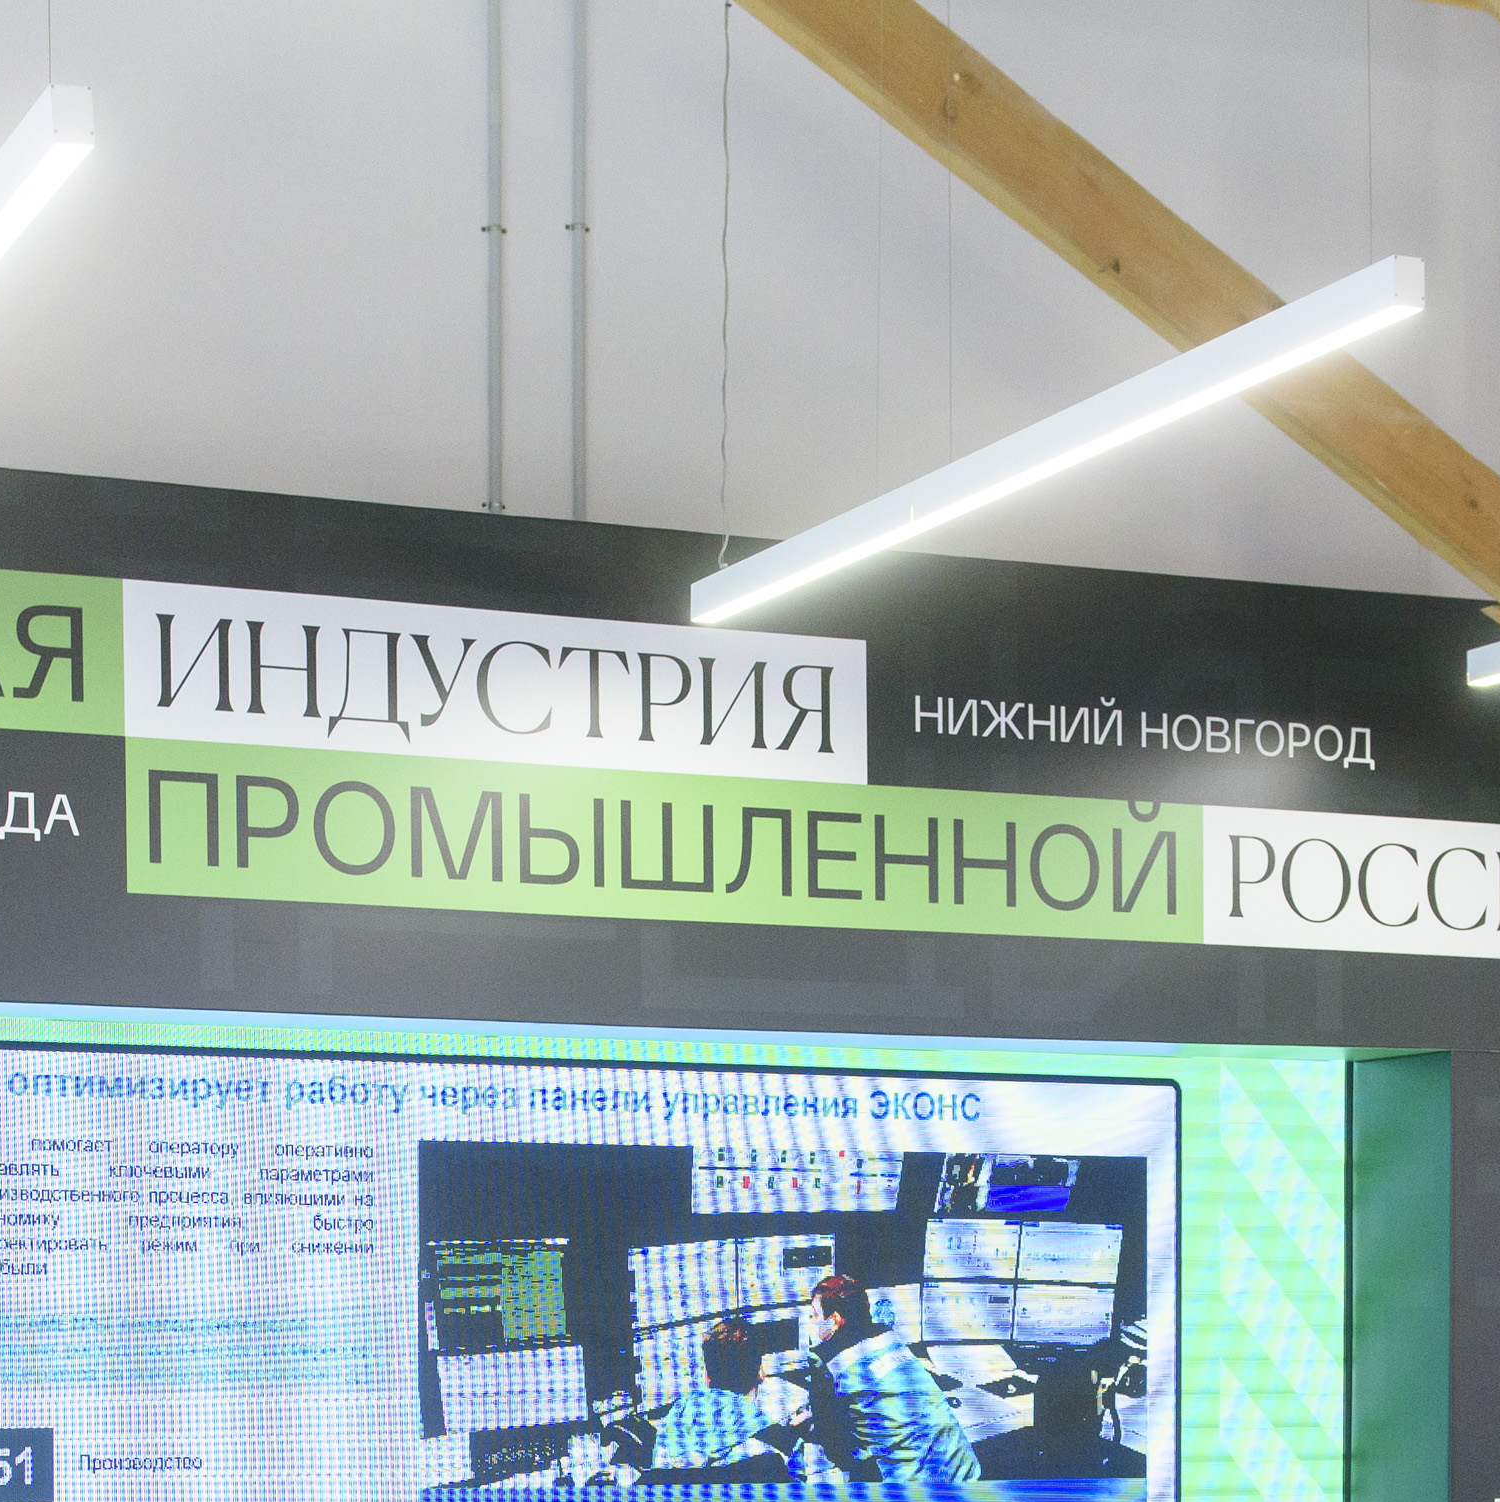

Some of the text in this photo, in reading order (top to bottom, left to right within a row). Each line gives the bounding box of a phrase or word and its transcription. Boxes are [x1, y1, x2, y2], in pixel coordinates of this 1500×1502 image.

[154, 613, 836, 755] ИНДУСТРИЯ
[913, 695, 1377, 772] НИЖНИЙ НОВГОРОД
[148, 768, 1179, 916] ПРОМЫШЛЕННОЙ
[8, 1072, 274, 1110] оптимизирует
[285, 1076, 408, 1113] работу
[419, 1084, 517, 1115] через
[529, 1086, 652, 1113] панели
[662, 1089, 859, 1121] управления
[868, 1090, 982, 1123] ЭКОНС
[31, 1138, 113, 1154] помогает
[148, 1141, 240, 1158] оператору
[274, 1144, 375, 1160] оперативно
[258, 1167, 375, 1184] параметрами
[78, 1453, 203, 1475] Производство
